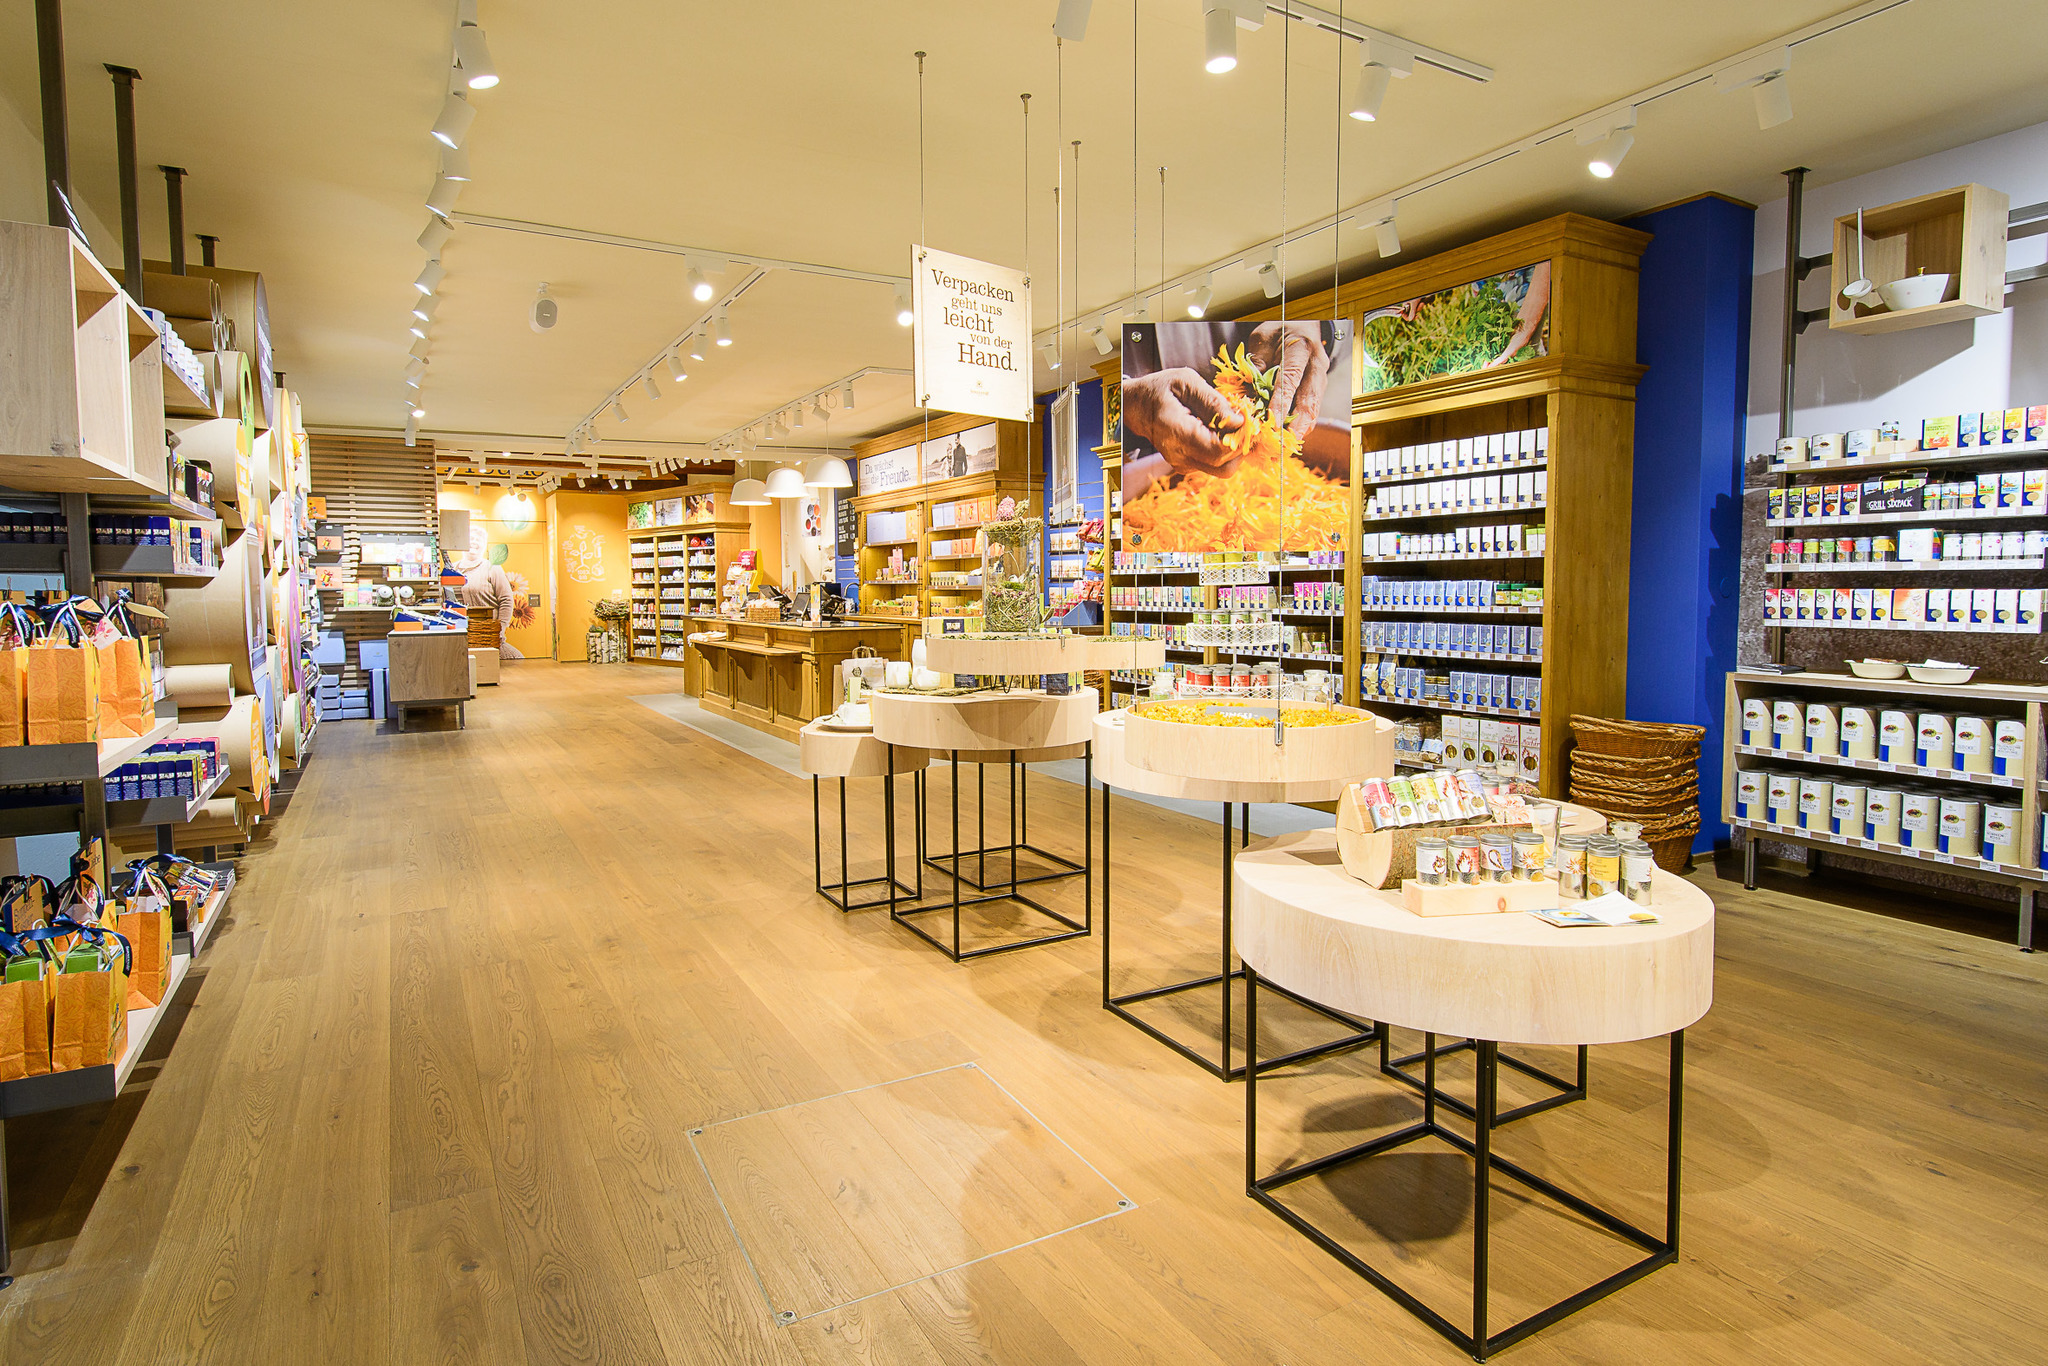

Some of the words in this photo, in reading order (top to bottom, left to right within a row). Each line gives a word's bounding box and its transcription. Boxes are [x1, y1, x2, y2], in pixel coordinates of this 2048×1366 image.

[931, 269, 1014, 302] Verpacken
[951, 297, 978, 310] geht
[981, 303, 1003, 317] uns
[943, 307, 994, 334] leicht
[970, 334, 991, 346] von
[994, 336, 1013, 350] der
[958, 342, 1018, 372] Hand.
[865, 464, 873, 475] Da
[880, 466, 911, 487] Freude.
[1869, 500, 1886, 511] GRILL
